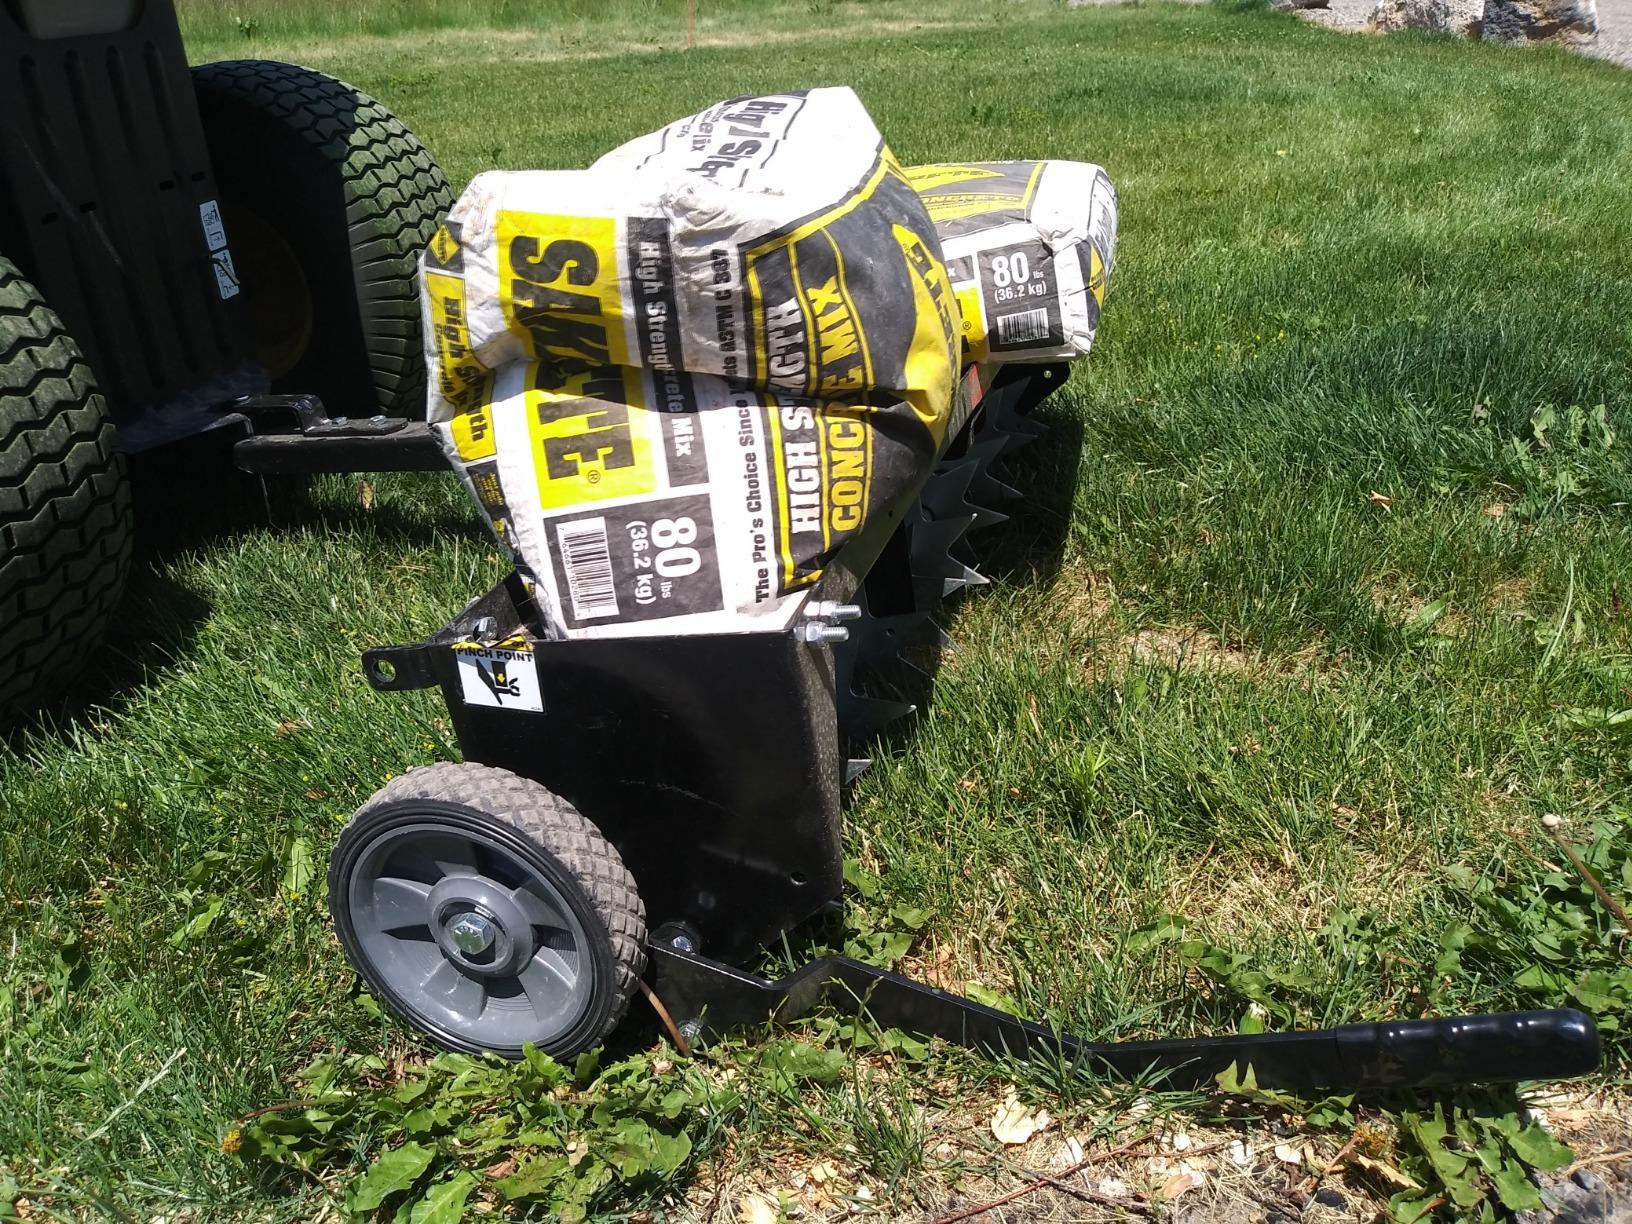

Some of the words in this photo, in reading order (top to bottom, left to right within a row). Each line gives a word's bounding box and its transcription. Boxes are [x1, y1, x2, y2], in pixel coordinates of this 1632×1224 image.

[711, 249, 730, 285] 387
[992, 251, 1030, 287] 80
[1033, 270, 1044, 280] lbs
[994, 286, 1025, 304] (36.2
[1028, 281, 1047, 296] kg)
[443, 297, 464, 358] High
[715, 305, 736, 351] ASTM
[806, 276, 861, 365] MIX
[635, 241, 661, 294] High
[670, 418, 694, 457] Mix
[735, 400, 755, 447] Since
[744, 452, 762, 512] Choice
[786, 441, 821, 534] HIGH
[625, 520, 651, 569] (36.2
[650, 516, 701, 578] 80
[750, 518, 767, 563] Pro's
[634, 575, 657, 605] kg)
[660, 581, 672, 599] lbs
[755, 568, 770, 603] The
[457, 648, 493, 659] PINCH
[496, 651, 533, 662] POINT
